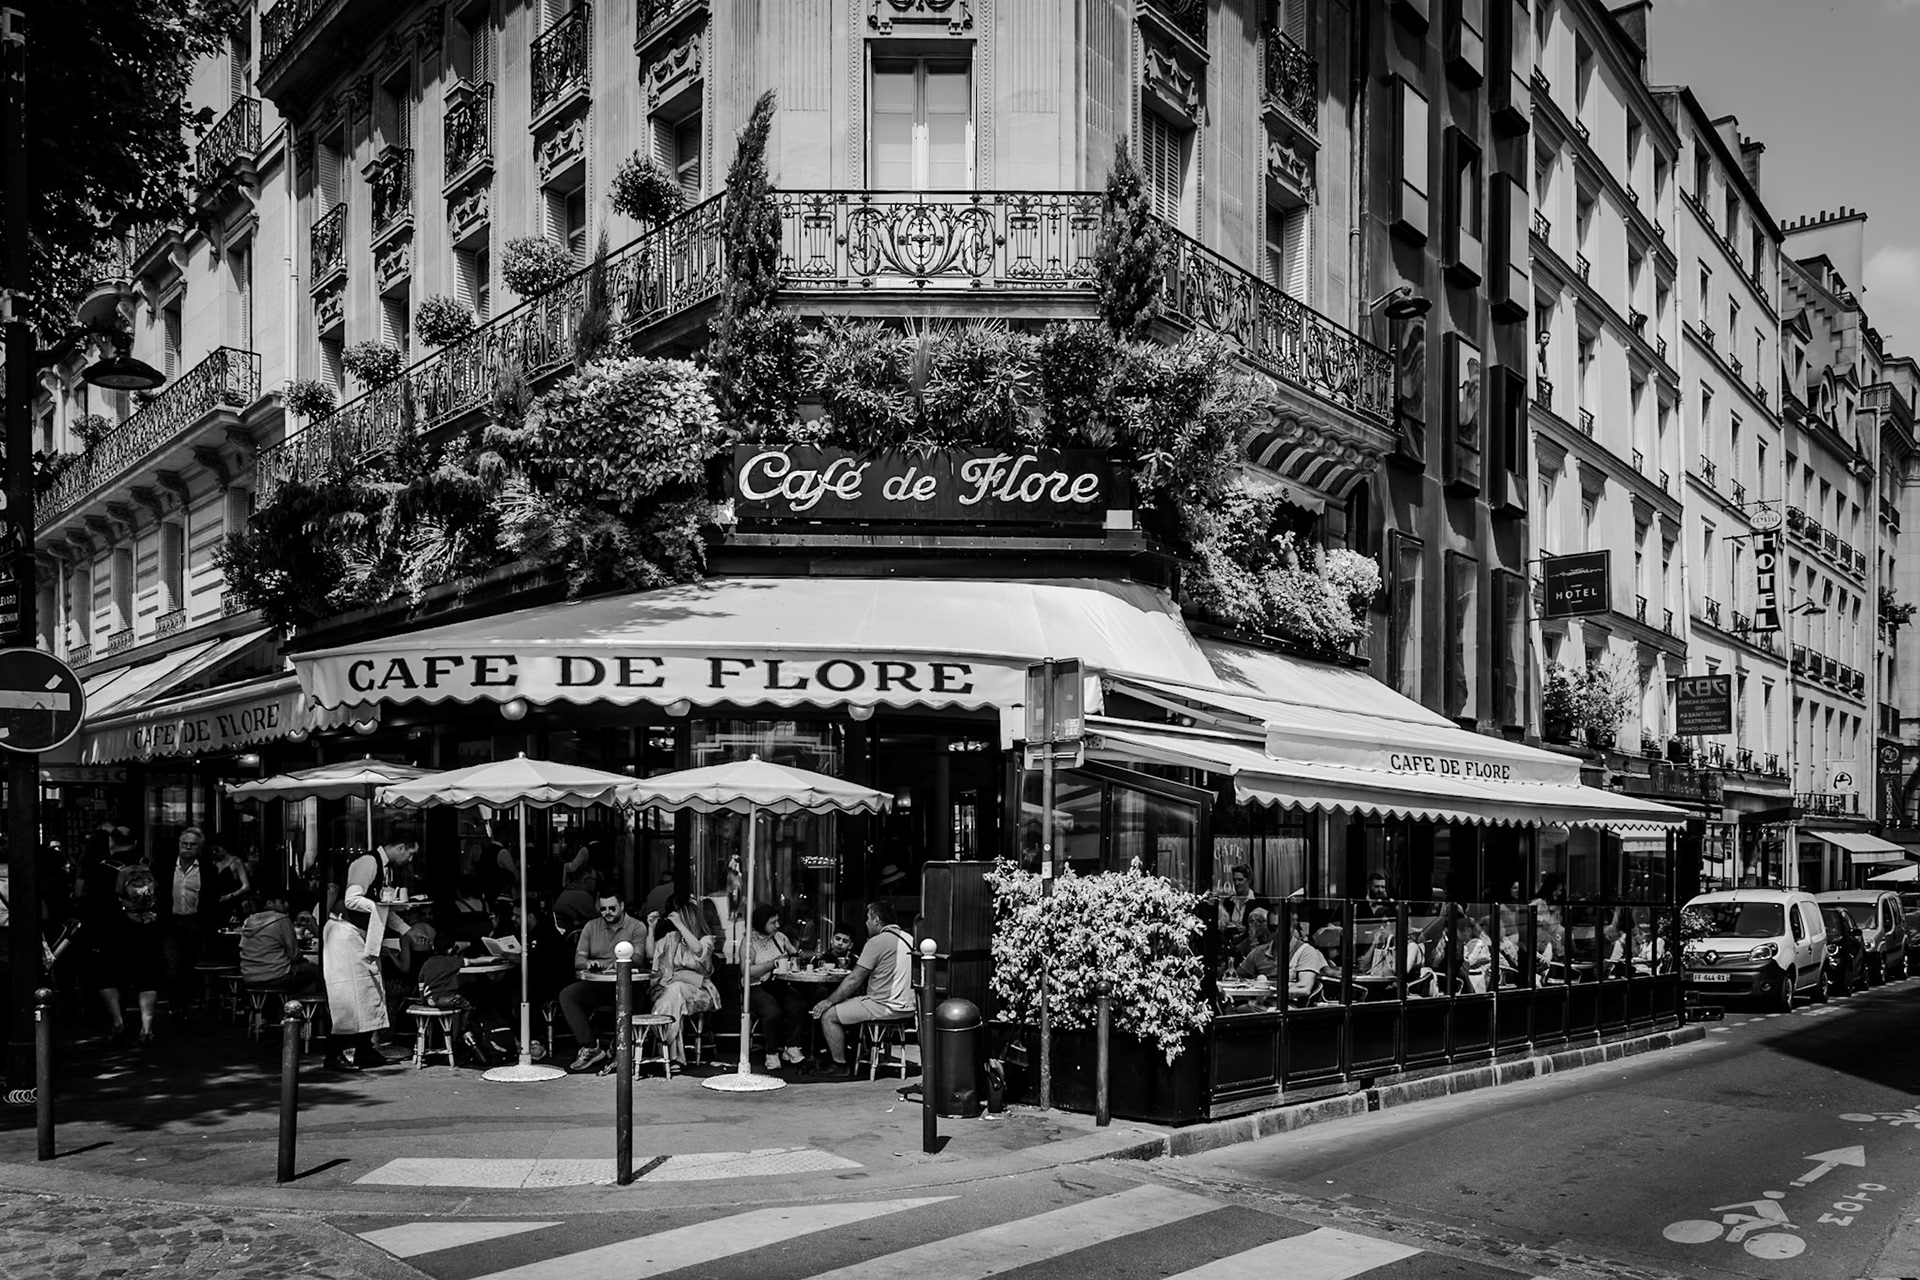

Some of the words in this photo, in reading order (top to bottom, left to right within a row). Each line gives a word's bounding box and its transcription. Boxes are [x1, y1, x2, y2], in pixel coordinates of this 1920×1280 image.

[738, 450, 871, 512] Café
[881, 466, 937, 502] de
[958, 452, 1100, 506] Flore
[1555, 588, 1598, 600] HOTEL
[1753, 532, 1779, 630] HOTEL
[348, 654, 519, 694] CAFE
[557, 656, 665, 689] DE
[708, 657, 974, 695] FLORE
[134, 724, 175, 750] CAFE
[184, 720, 210, 743] DE
[216, 703, 280, 738] FLORE
[1390, 754, 1435, 772] CAFE
[1440, 758, 1460, 775] DE
[1465, 761, 1511, 780] FLORE
[1816, 1182, 1888, 1227] MOTO
